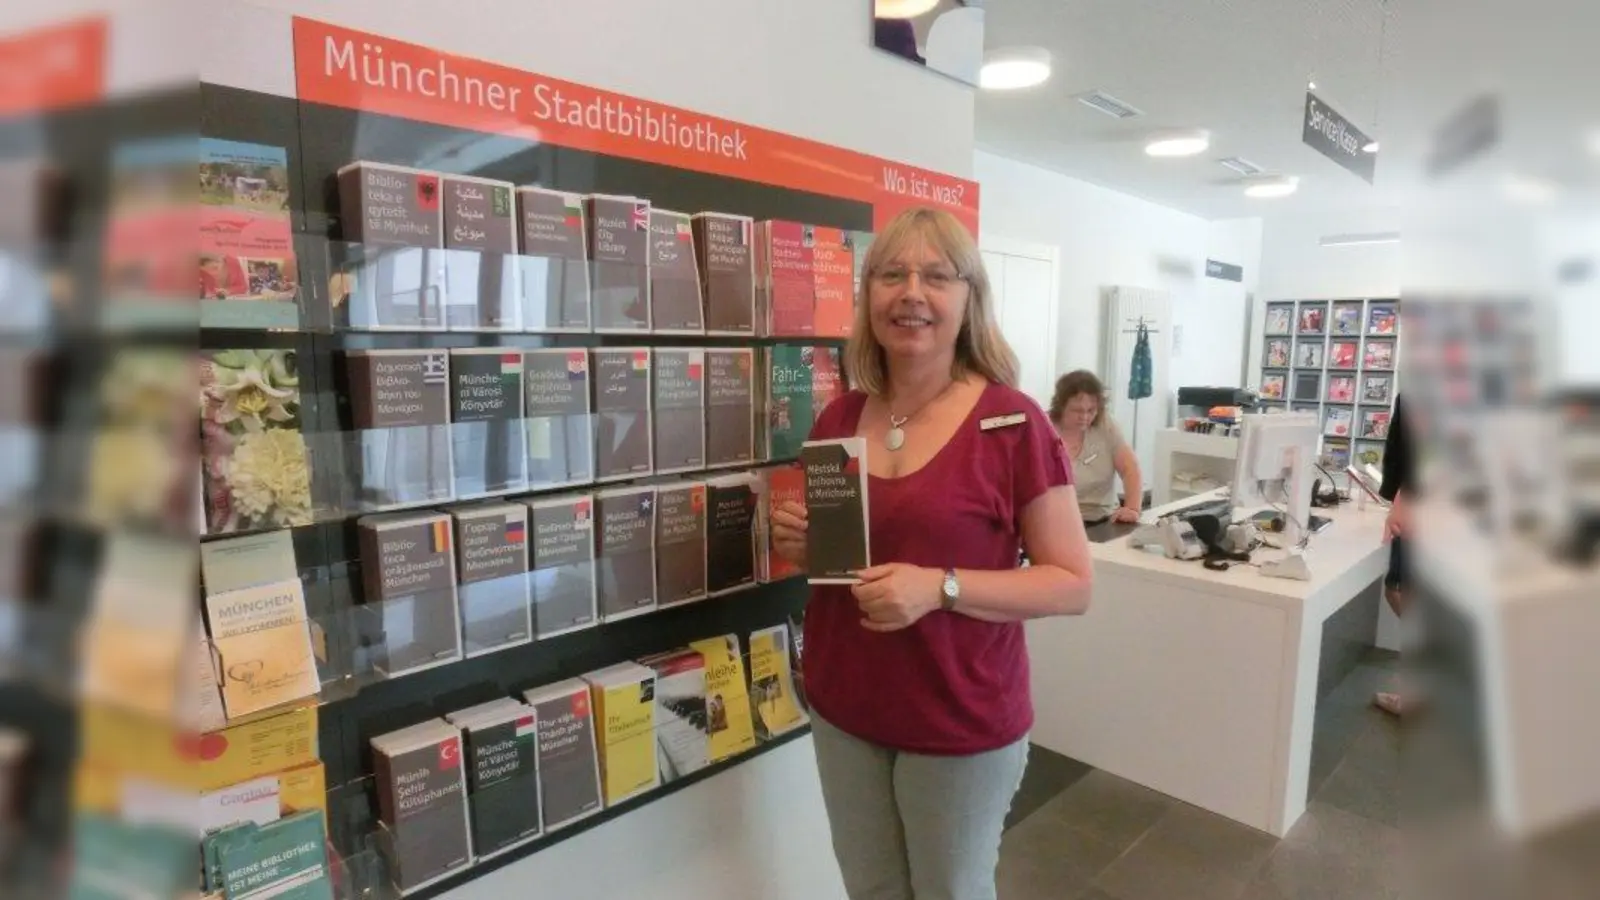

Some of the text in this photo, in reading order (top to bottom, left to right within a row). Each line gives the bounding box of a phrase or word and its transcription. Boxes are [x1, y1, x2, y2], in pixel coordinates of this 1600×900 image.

[323, 34, 748, 161] Münchner Stadtbibliothek
[882, 166, 965, 206] Wo ist was?
[597, 217, 627, 230] Munich
[598, 229, 614, 242] City
[597, 241, 627, 255] Library
[459, 374, 502, 386] Münche-
[772, 365, 804, 383] Fahr-
[460, 399, 503, 412] Könyvtár
[218, 593, 294, 619] MÜNCHEN
[705, 662, 738, 681] nleihe
[477, 739, 517, 757] Münche-
[478, 759, 521, 781] Könyvtár
[228, 841, 318, 881] MEINE BIBLIOTHEK
[247, 867, 279, 886] MEINE
